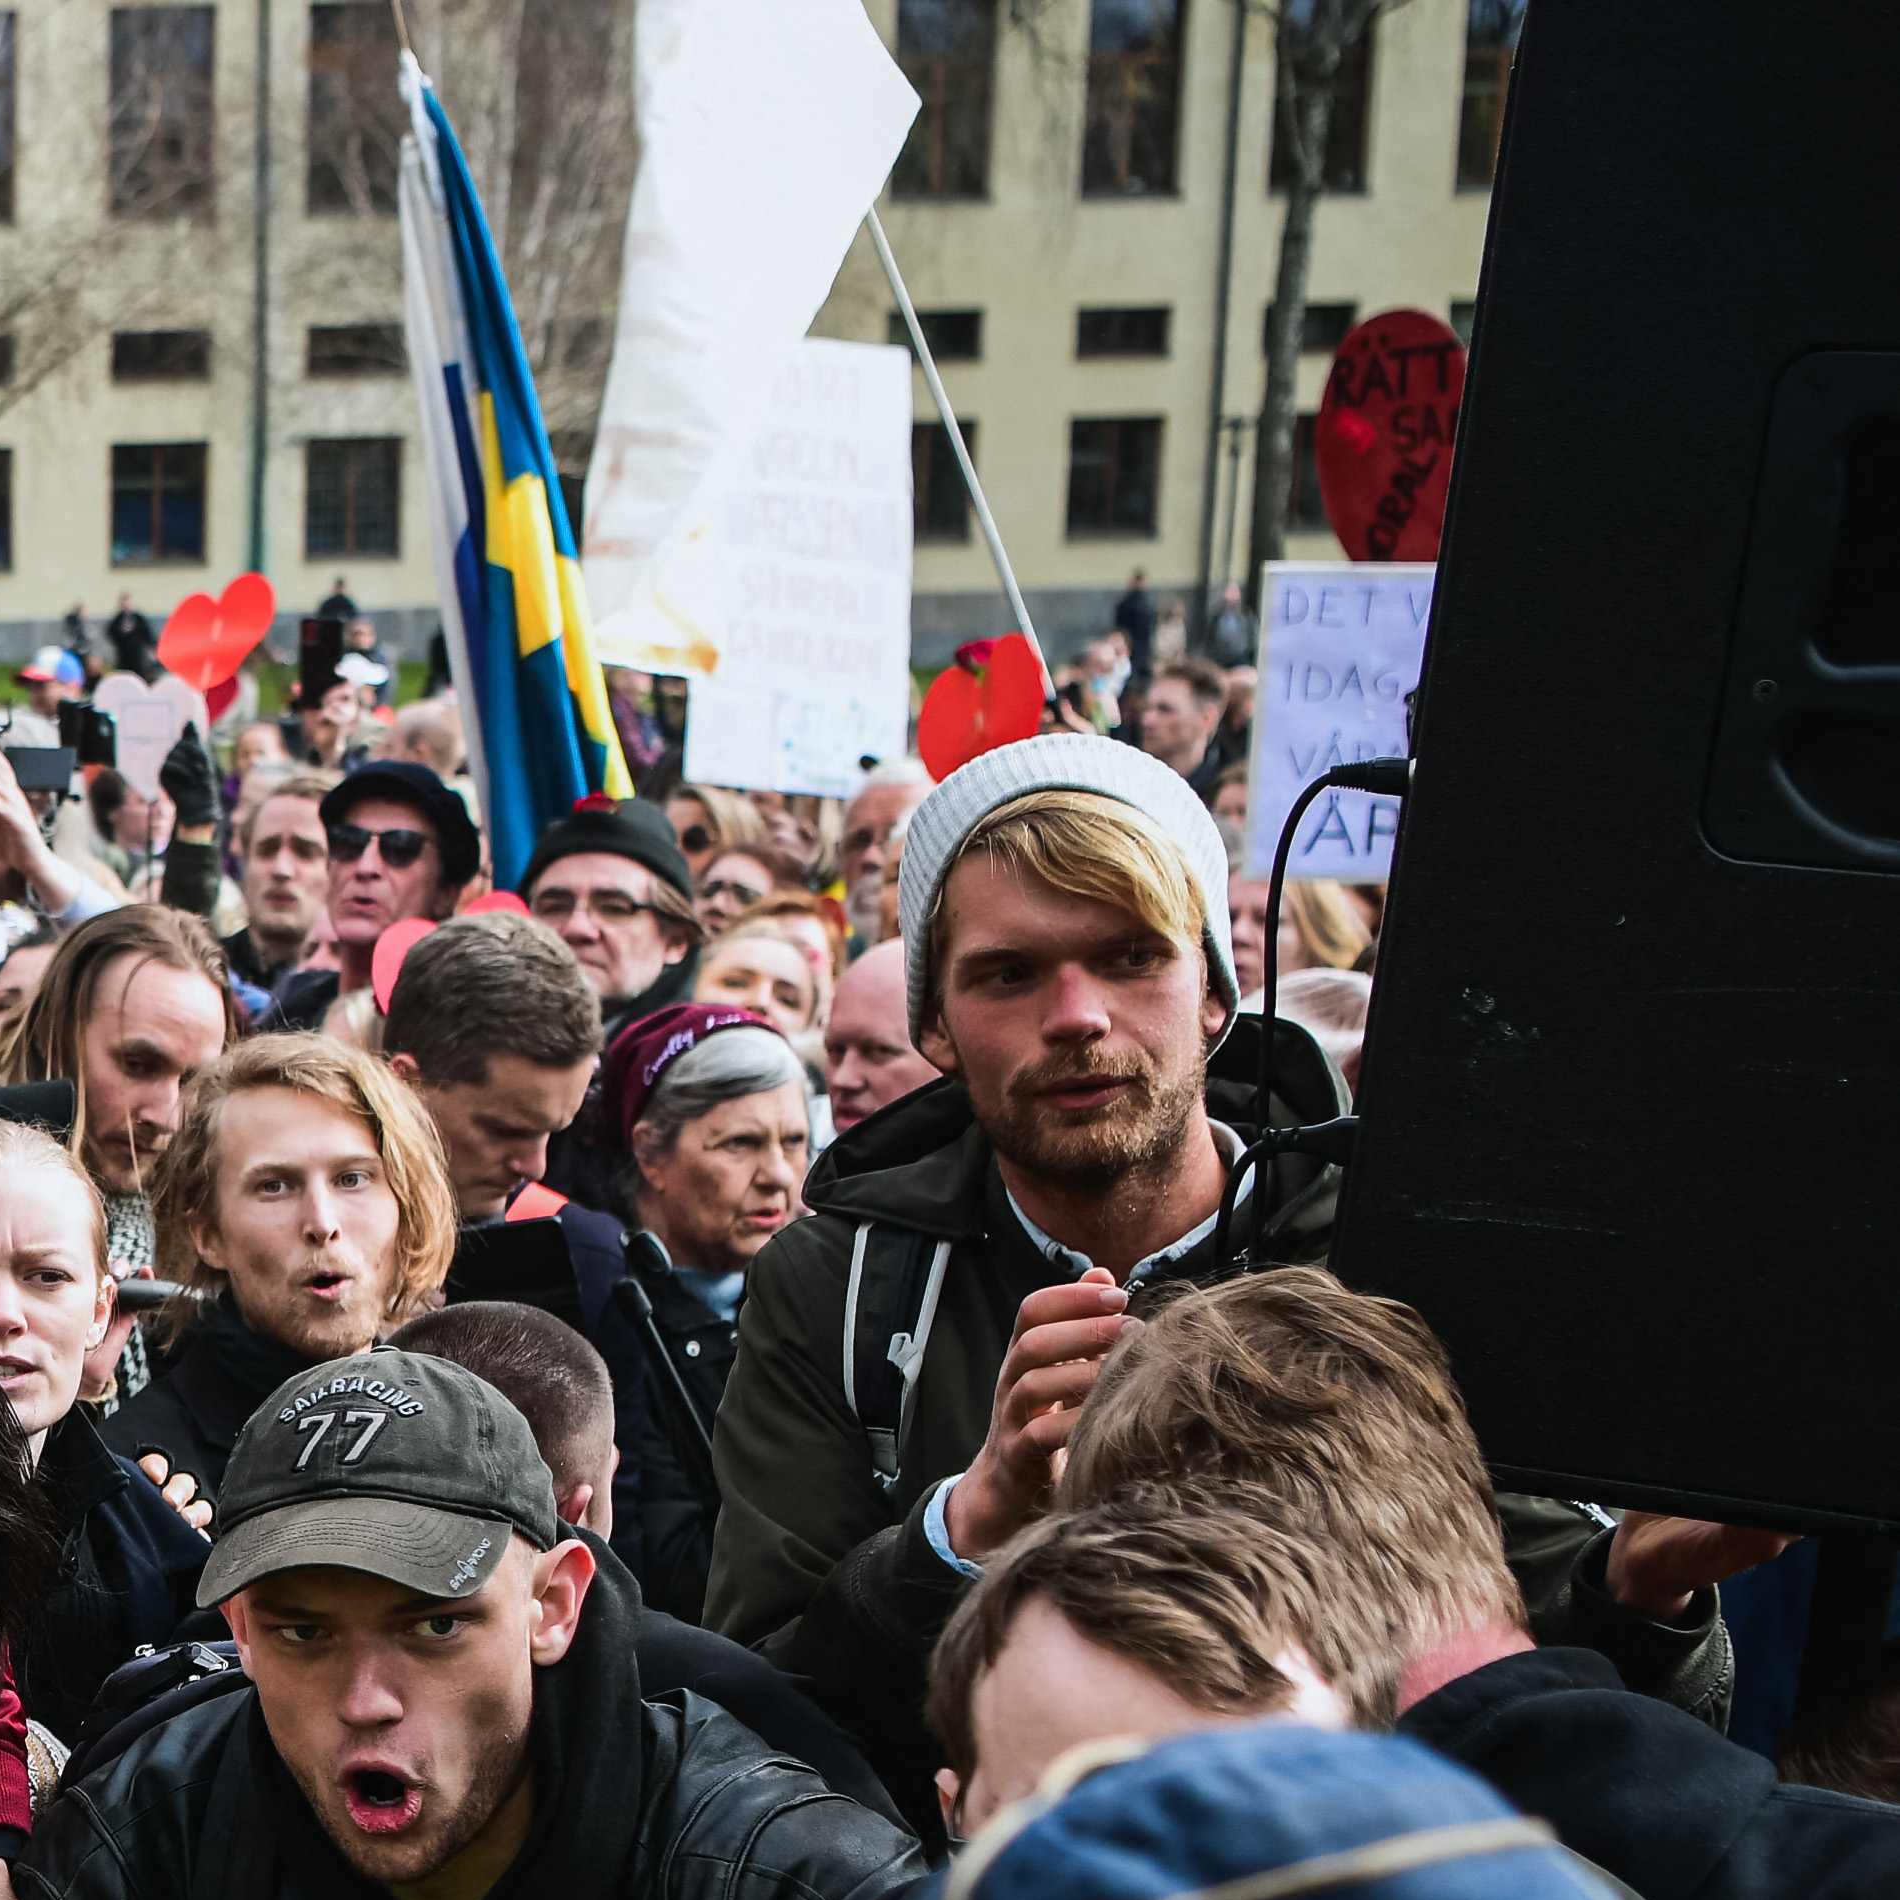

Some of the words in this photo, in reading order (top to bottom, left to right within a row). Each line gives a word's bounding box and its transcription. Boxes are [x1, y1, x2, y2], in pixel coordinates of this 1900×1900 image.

[1282, 584, 1385, 629] DET
[1286, 661, 1400, 701] IDAG
[330, 1376, 424, 1417] RACING
[296, 1410, 388, 1468] 77
